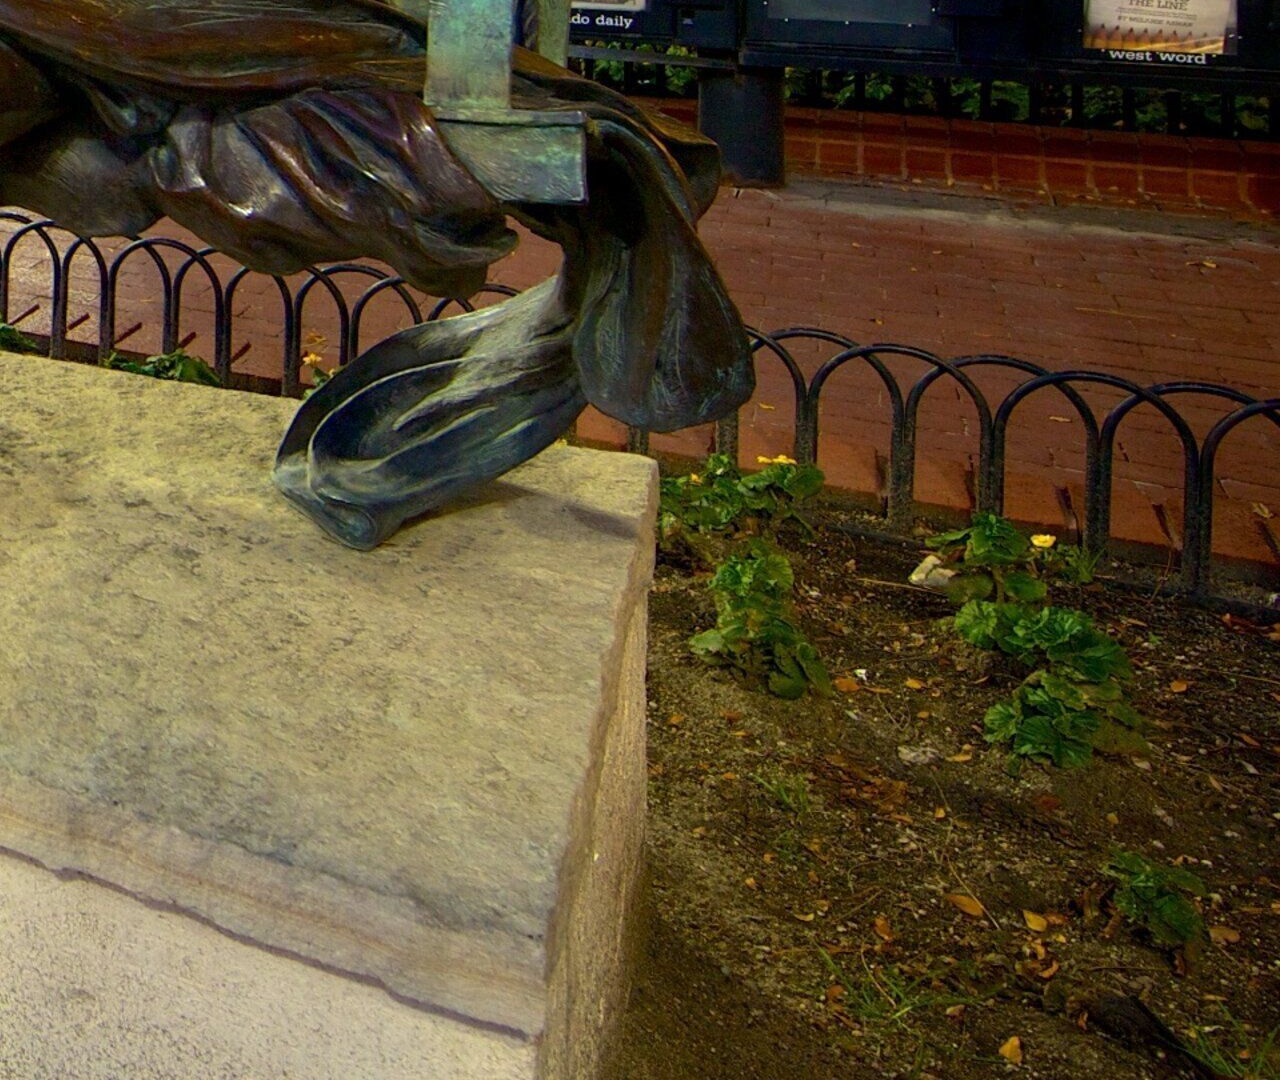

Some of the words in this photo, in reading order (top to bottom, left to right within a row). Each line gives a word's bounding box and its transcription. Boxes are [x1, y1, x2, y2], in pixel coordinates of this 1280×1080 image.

[1157, 0, 1188, 11] LINE
[568, 13, 590, 24] do
[595, 14, 633, 29] daily
[1109, 50, 1153, 61] west
[1158, 52, 1207, 65] word
